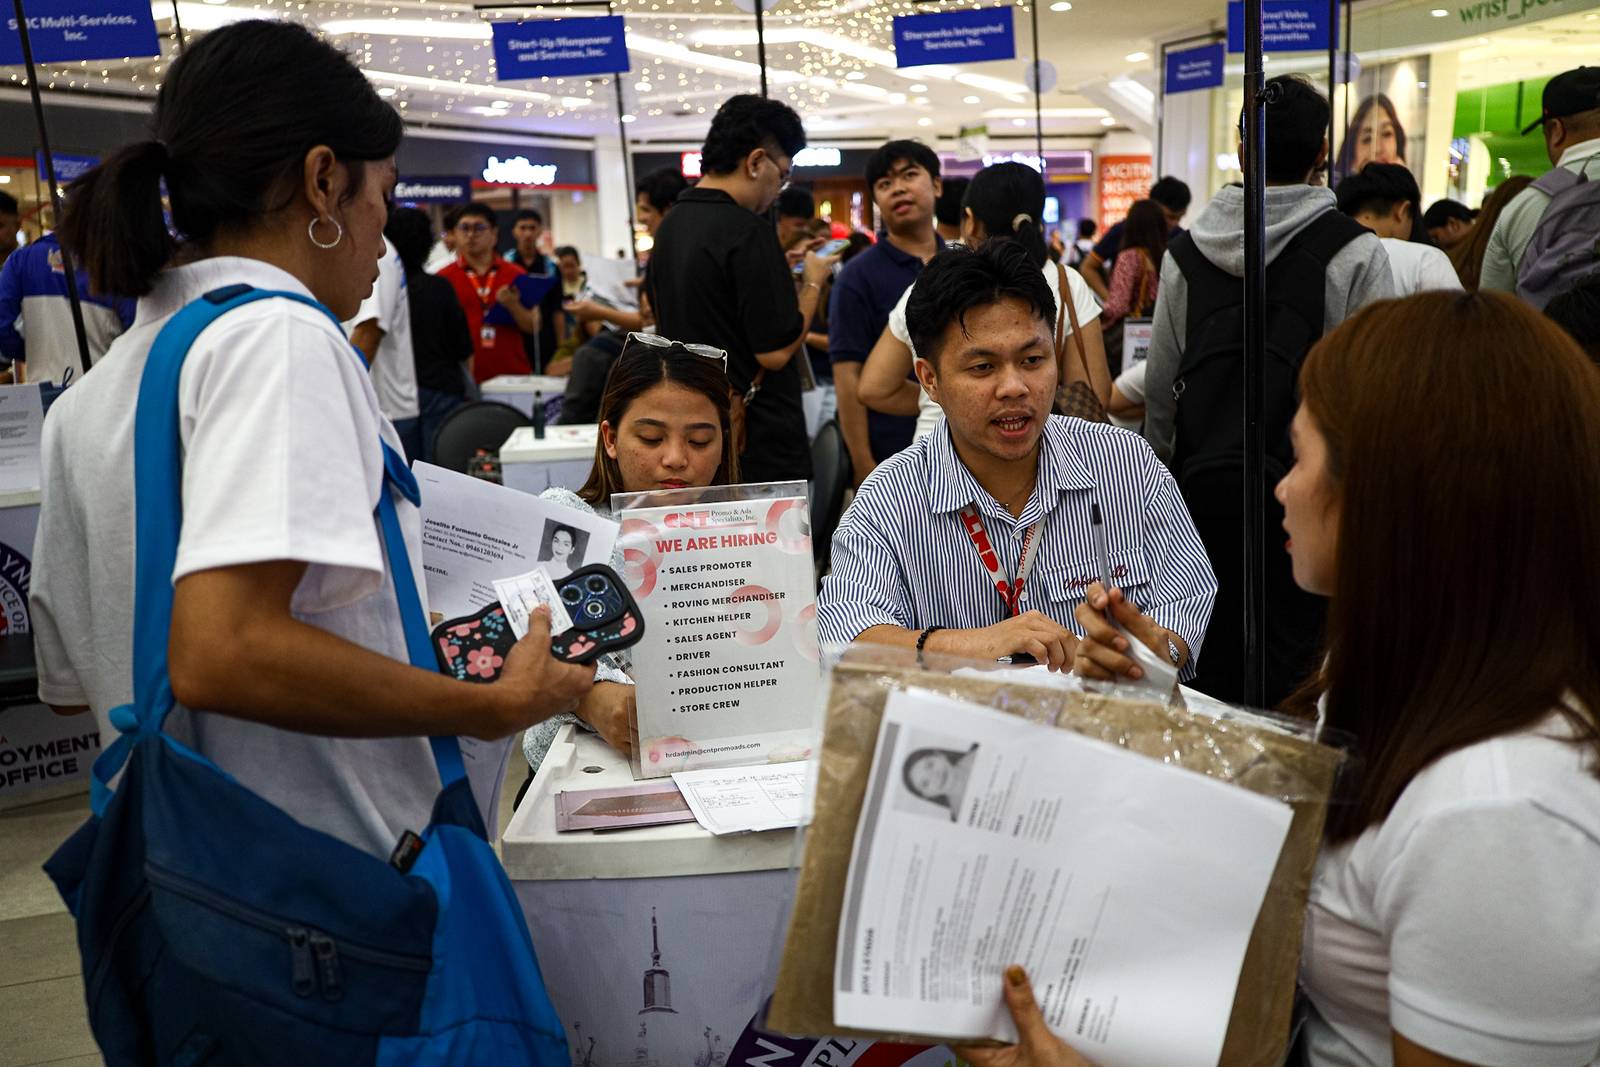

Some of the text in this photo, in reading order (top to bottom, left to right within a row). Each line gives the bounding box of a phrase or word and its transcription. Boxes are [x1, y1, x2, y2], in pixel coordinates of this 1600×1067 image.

[64, 30, 87, 41] Inc.
[518, 51, 538, 62] and
[394, 182, 463, 198] Entrance
[711, 509, 732, 517] Promo
[423, 532, 448, 544] Contact
[656, 532, 778, 553] WE ARE HIRING
[669, 561, 752, 574] SALES PROMOTER
[670, 579, 745, 591] MERCHANDISER
[672, 592, 785, 609] ROVING MERCHANDISER
[673, 613, 751, 626] KITCHEN HELPER
[674, 631, 737, 644] SALES AGENT
[676, 651, 711, 661] DRIVER
[677, 661, 785, 678] FASHION CONSULTANT
[678, 678, 778, 695] PRODUCTION HELPER
[680, 700, 740, 713] STORE CREW
[0, 732, 100, 767] OYMENT
